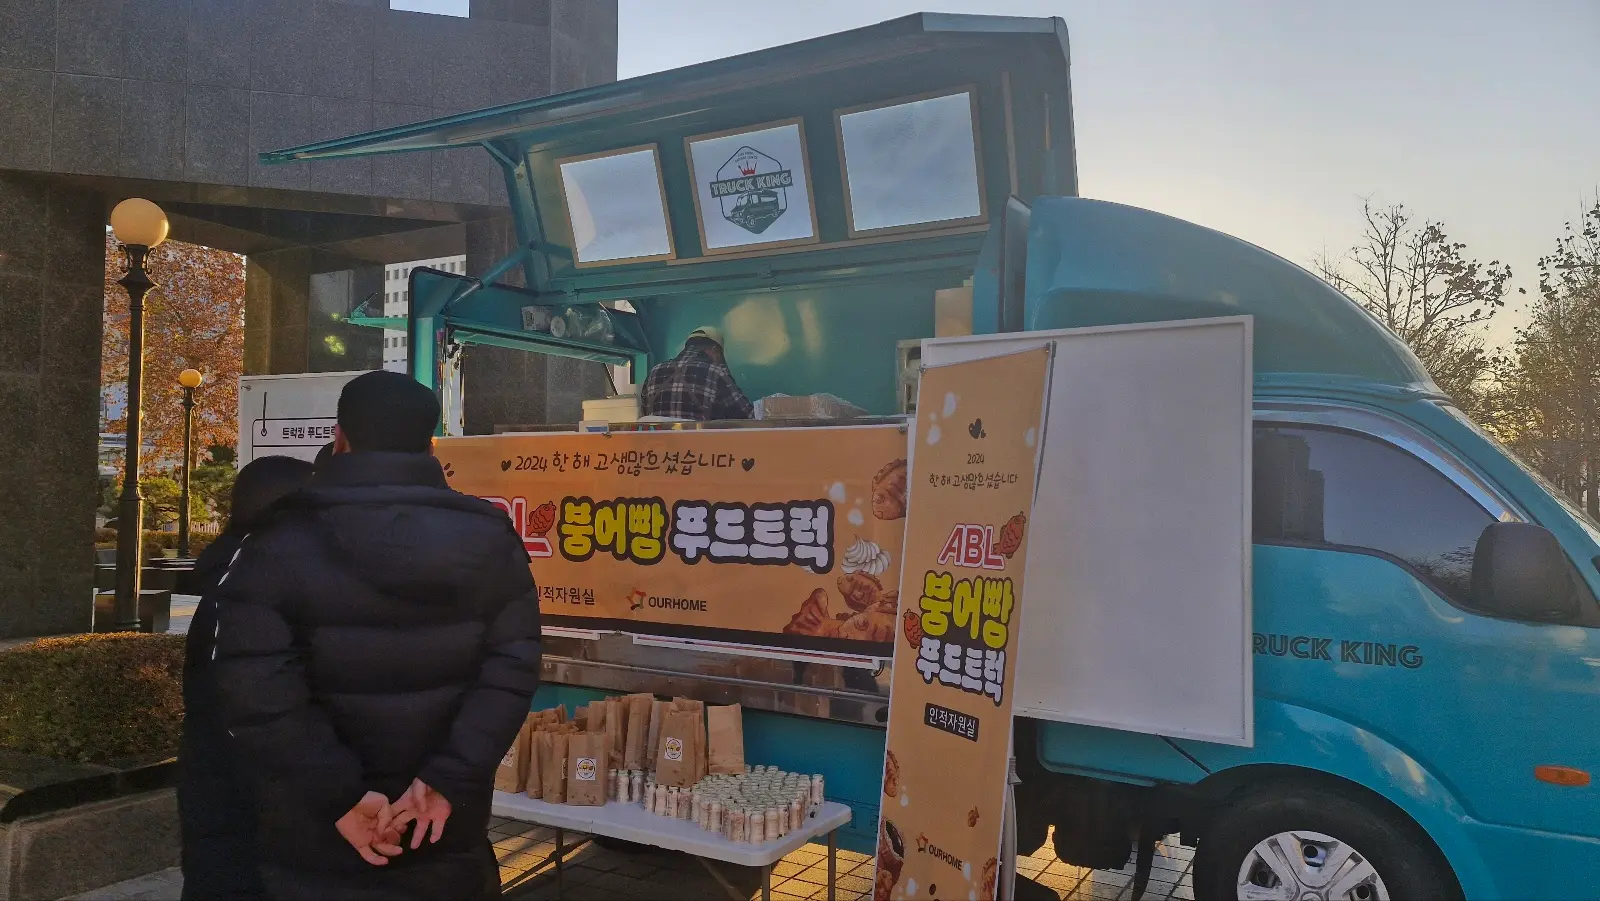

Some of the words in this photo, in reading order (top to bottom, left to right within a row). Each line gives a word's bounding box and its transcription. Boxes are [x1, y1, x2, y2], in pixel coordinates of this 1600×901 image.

[711, 178, 755, 196] TRUCK
[756, 172, 791, 189] KING
[282, 426, 306, 439] 트럭킹
[514, 455, 548, 472] 2024
[552, 451, 569, 473] 한
[572, 451, 590, 470] 해
[966, 453, 985, 465] 2024
[558, 497, 668, 564] 붕어빵
[669, 500, 833, 573] 푸드트럭
[937, 523, 1005, 571] ABL
[648, 596, 708, 613] OURHOME
[919, 570, 1015, 650] 붕어빵
[1252, 632, 1333, 661] RUCK
[1340, 639, 1424, 669] KING
[915, 636, 1006, 707] 푸드트럭
[928, 706, 977, 739] 인적자원실
[928, 844, 963, 872] OURHOME
